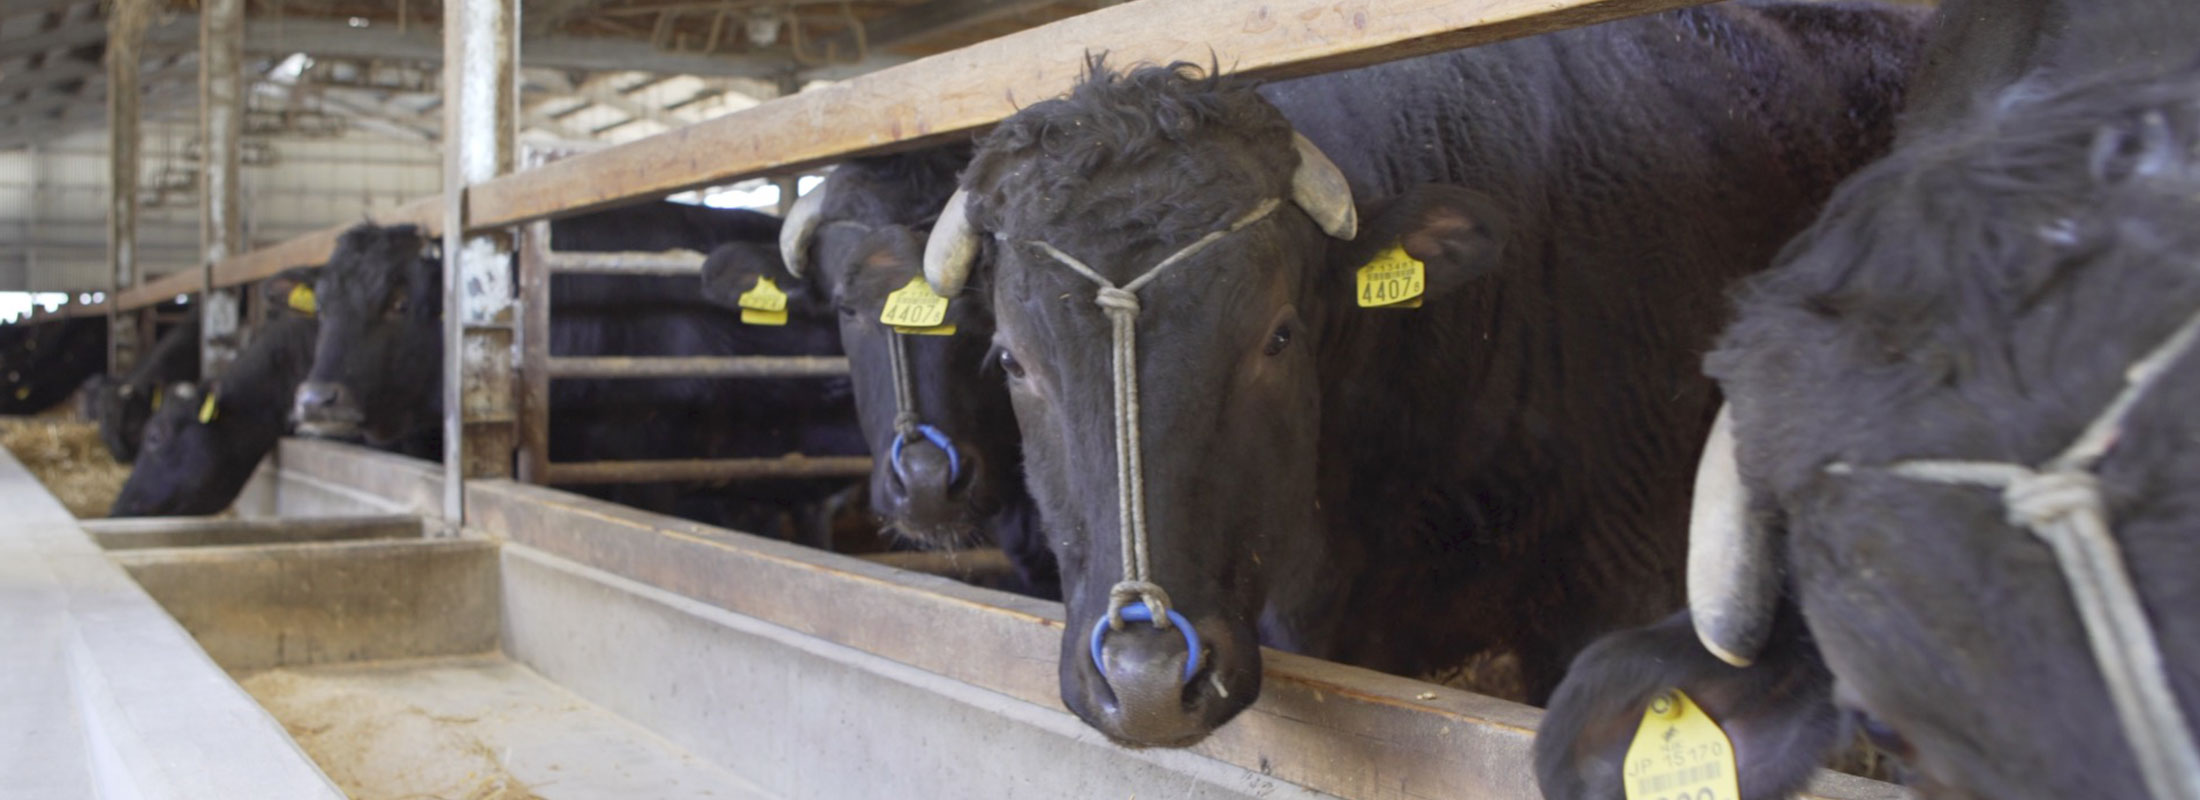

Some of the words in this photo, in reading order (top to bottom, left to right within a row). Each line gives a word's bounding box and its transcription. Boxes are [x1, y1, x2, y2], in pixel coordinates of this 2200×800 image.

[1362, 276, 1412, 303] 4407
[886, 304, 935, 323] 4407
[1629, 759, 1652, 777] JP
[1664, 742, 1722, 767] 15170
